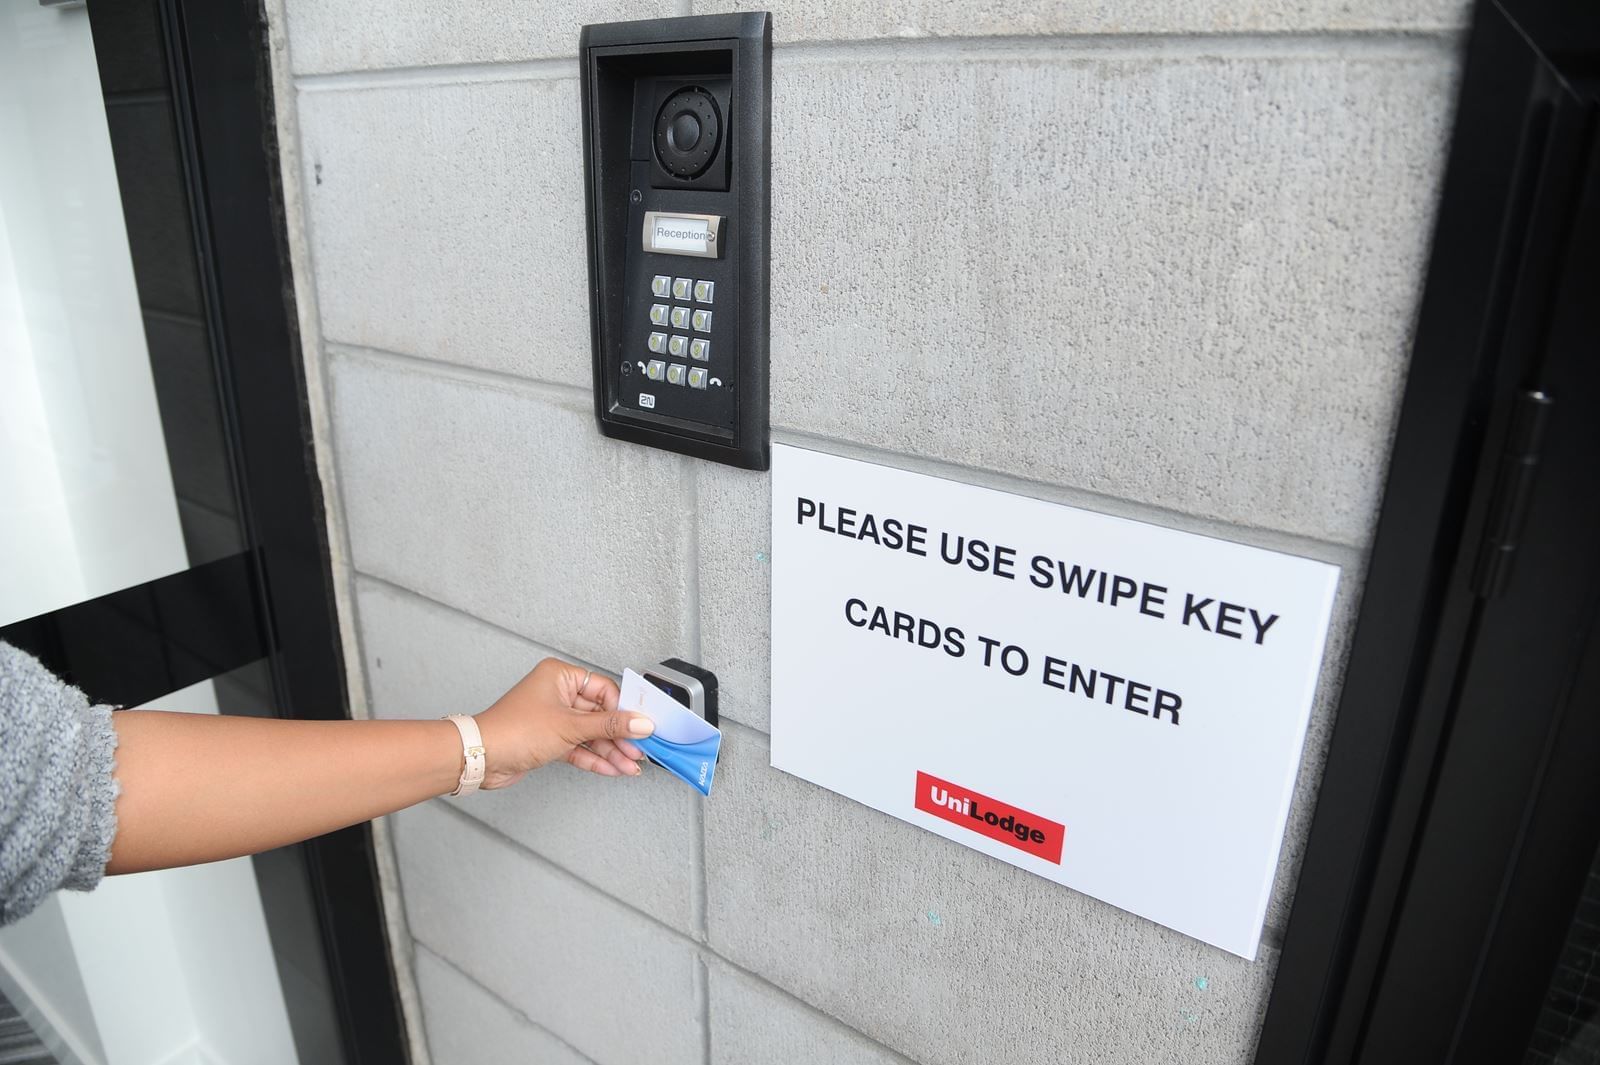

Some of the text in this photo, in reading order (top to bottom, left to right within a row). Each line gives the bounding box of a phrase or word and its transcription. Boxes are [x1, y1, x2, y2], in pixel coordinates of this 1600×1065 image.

[656, 227, 706, 241] Reception
[797, 496, 1280, 645] PLEASE USE SWIPE KEY
[845, 598, 1183, 726] CARDS TO ENTER
[930, 785, 1046, 844] UniLodge
